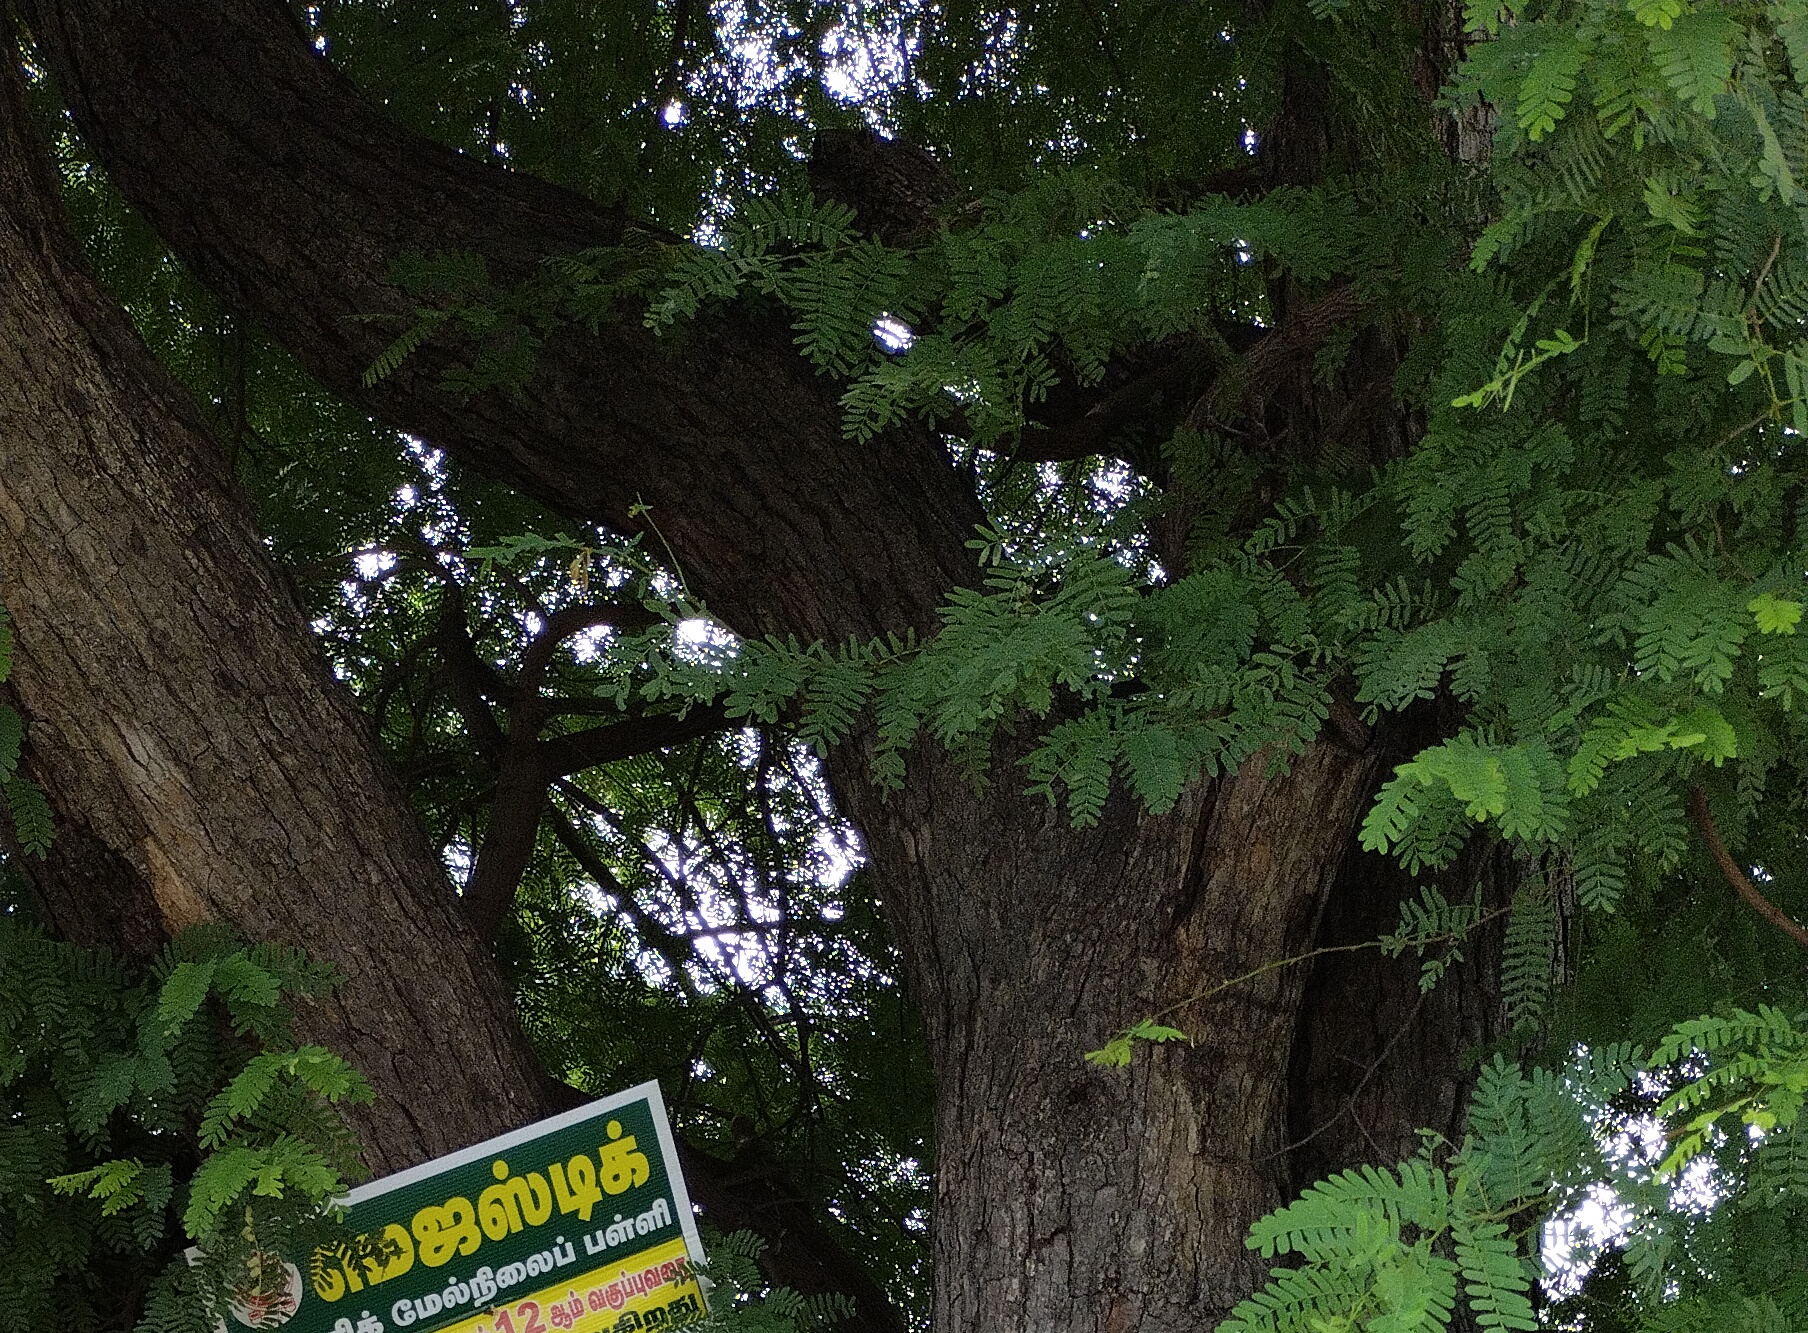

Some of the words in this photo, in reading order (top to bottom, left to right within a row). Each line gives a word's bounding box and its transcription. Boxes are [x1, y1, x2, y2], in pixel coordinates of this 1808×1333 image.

[310, 1119, 650, 1303] மெஜஸ்டிக்
[391, 1237, 577, 1327] மேல்நிலைப்
[584, 1198, 673, 1256] பள்ளி
[550, 1289, 585, 1330] ஆம்
[587, 1256, 694, 1311] வகுப்புவரை
